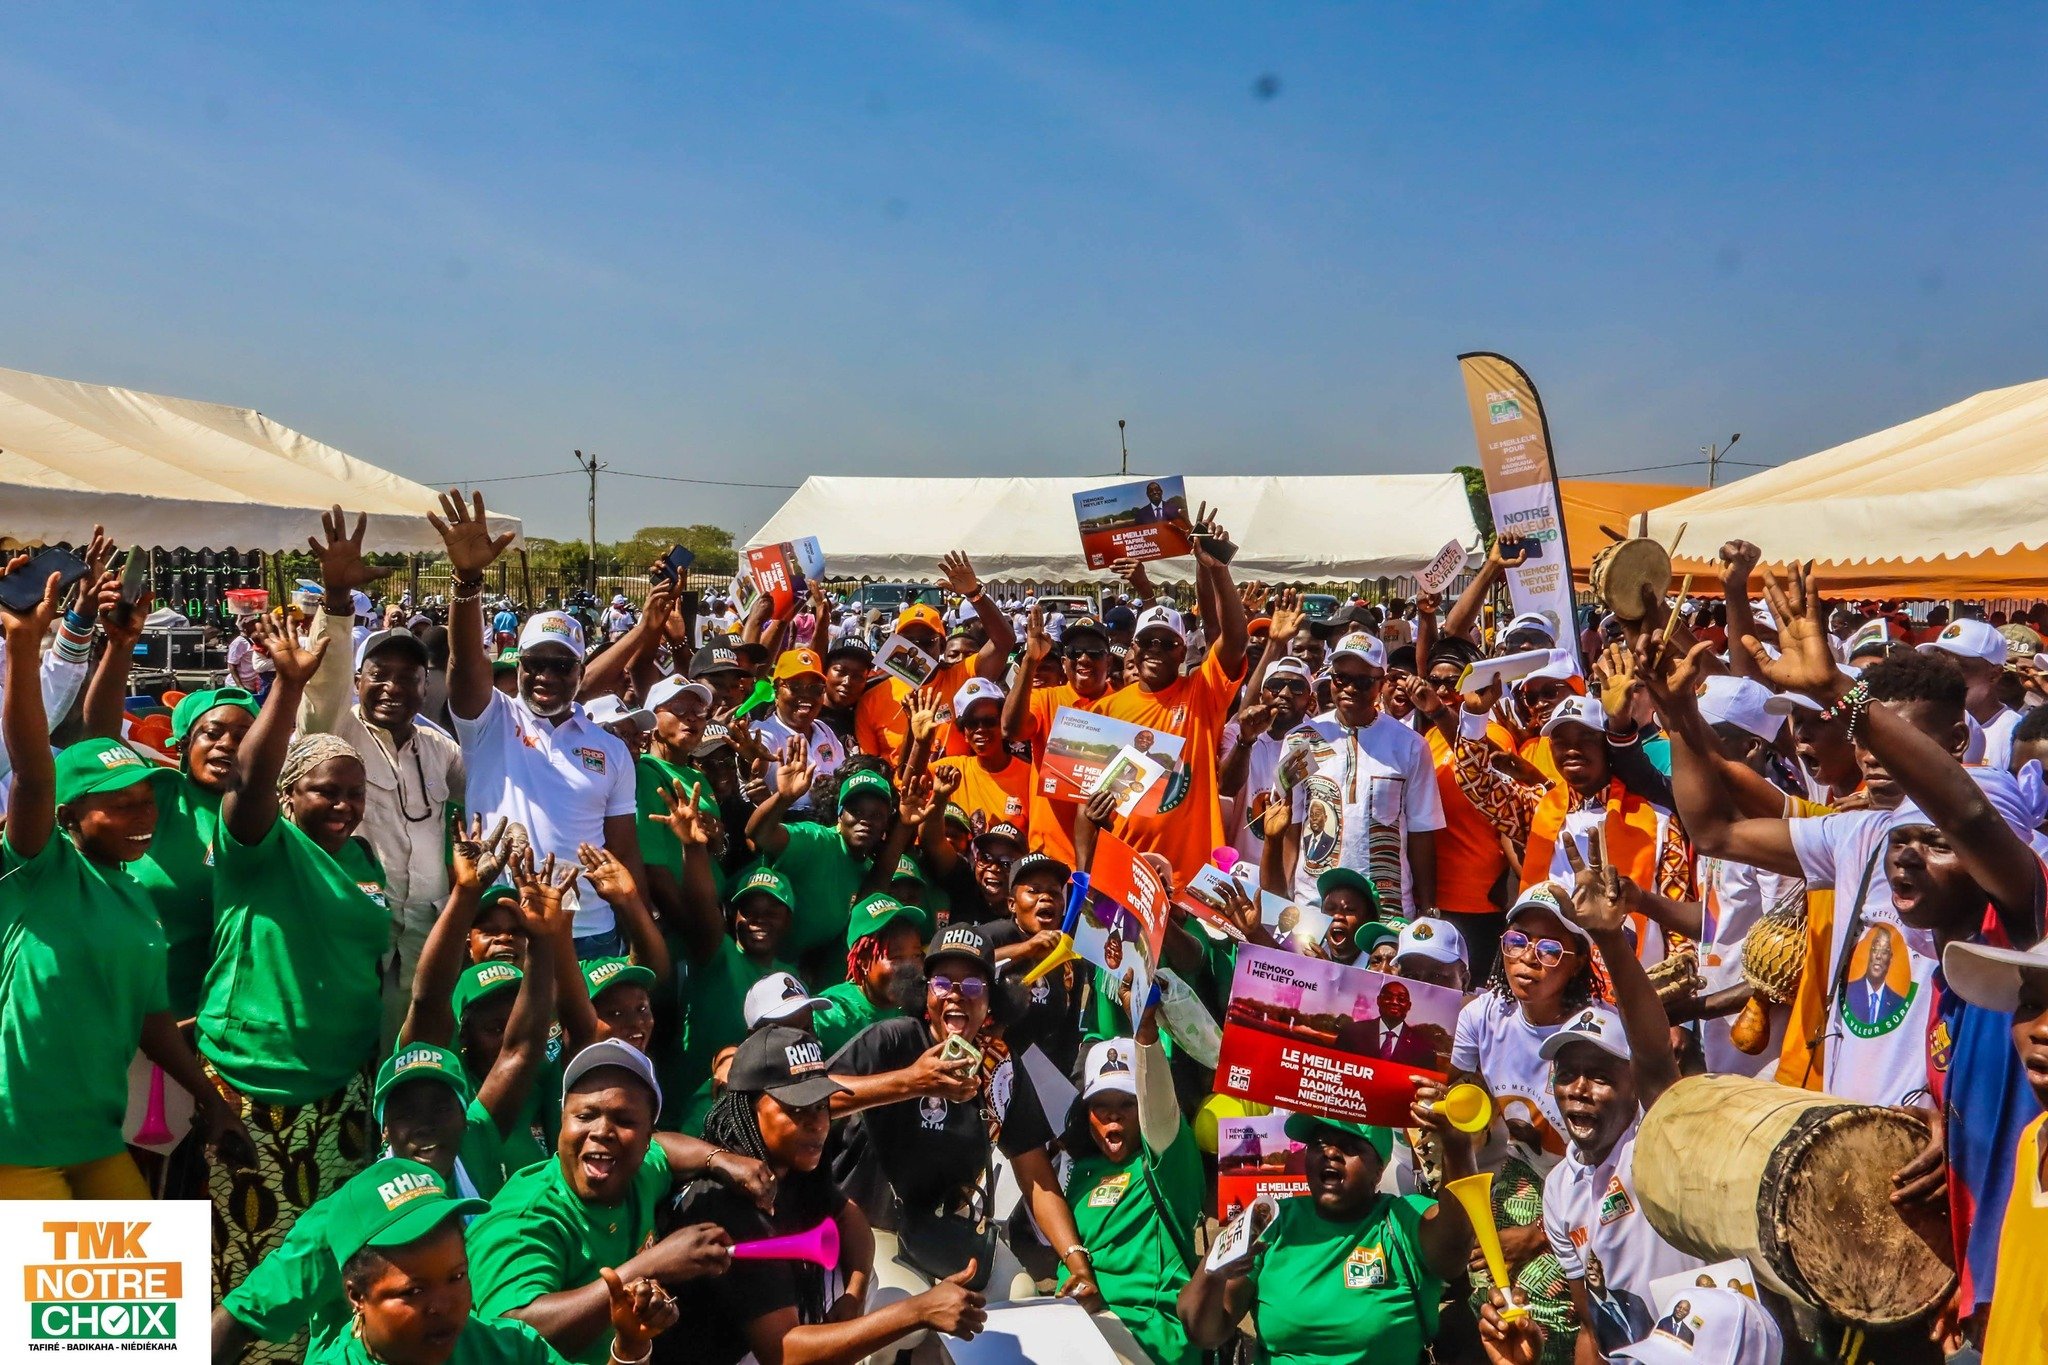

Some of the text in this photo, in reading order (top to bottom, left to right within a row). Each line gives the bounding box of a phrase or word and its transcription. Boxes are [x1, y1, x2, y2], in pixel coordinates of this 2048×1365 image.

[1489, 434, 1538, 450] LE MEILLEUR
[1503, 444, 1525, 455] POUR
[1503, 506, 1550, 525] NOTRE
[1112, 528, 1158, 542] LE MEILLEUR
[1503, 516, 1556, 538] VALEUR
[1424, 545, 1452, 578] NOTRE
[1425, 549, 1458, 584] VALEUR
[1520, 572, 1560, 587] MEYLIET
[728, 634, 745, 644] RH
[712, 648, 738, 660] RHDP
[97, 747, 137, 765] RHDP
[583, 750, 604, 758] RHDP
[1073, 764, 1085, 774] LE
[849, 775, 878, 788] RHDP
[990, 822, 1018, 836] RHDP
[943, 929, 984, 948] RHDP
[477, 965, 516, 982] RHDP
[589, 962, 625, 982] RHDP
[1254, 960, 1295, 977] TIÉMOKO
[1251, 969, 1318, 992] MEYLIET KONÉ
[1032, 997, 1047, 1005] KTM
[1850, 1021, 1880, 1036] VALEUR
[1885, 1001, 1910, 1029] SÛRE
[395, 1049, 443, 1069] RHDP
[1280, 1061, 1300, 1072] POUR
[1281, 1047, 1374, 1080] LE MEILLEUR
[1230, 1065, 1252, 1076] RHDP
[1302, 1066, 1344, 1086] TAFIRÉ,
[1299, 1078, 1365, 1101] BADIKAHA,
[1512, 1084, 1546, 1107] MEYLIET
[1297, 1089, 1368, 1112] NIÉDIÉKAHA
[1298, 1100, 1313, 1109] POUR
[1328, 1107, 1348, 1116] GRANDE
[1347, 1110, 1367, 1118] NATION
[921, 1120, 945, 1131] KTM
[377, 1173, 435, 1202] RHDP
[1256, 1182, 1267, 1192] LE
